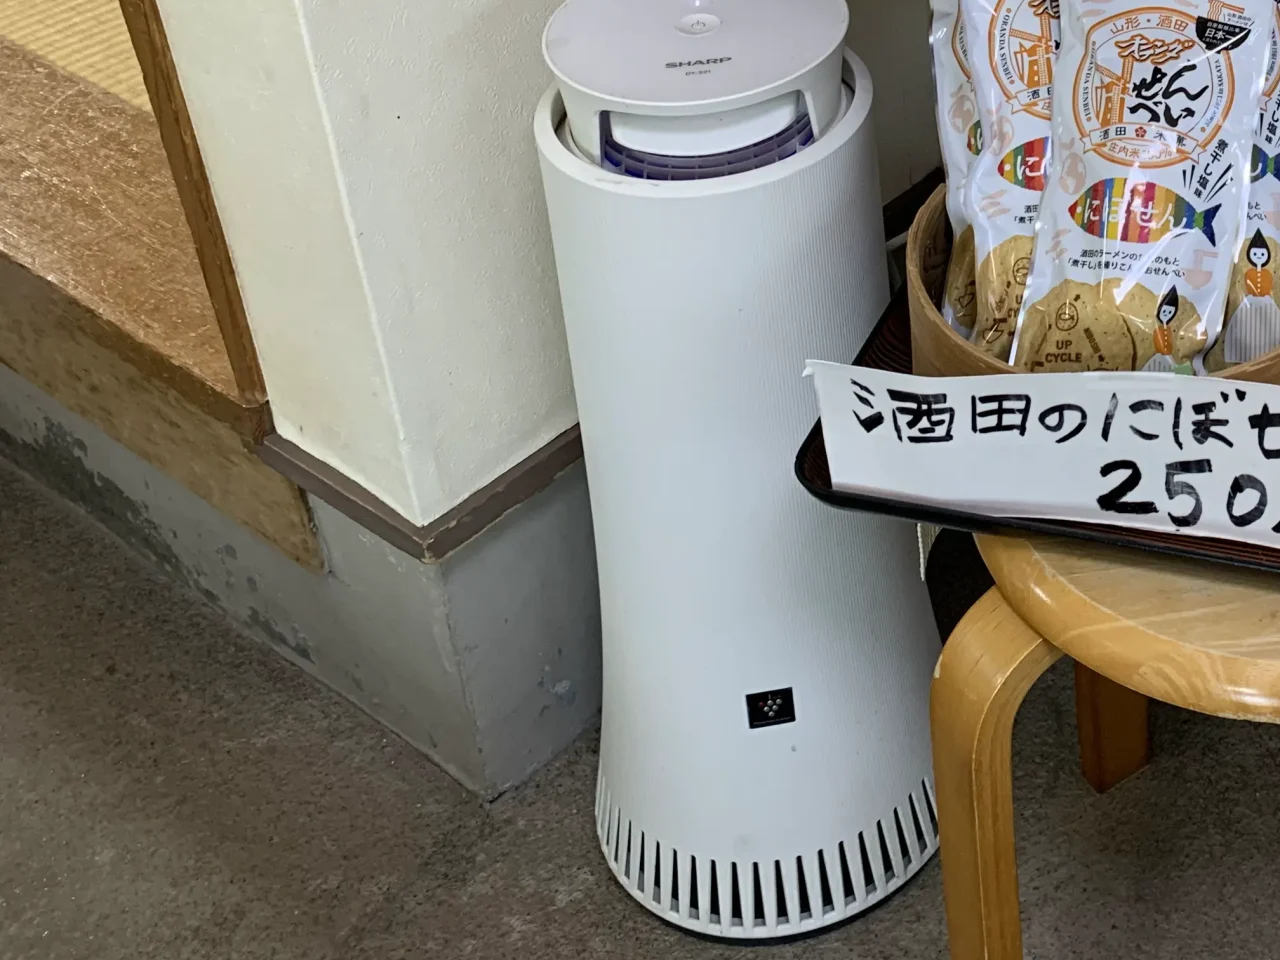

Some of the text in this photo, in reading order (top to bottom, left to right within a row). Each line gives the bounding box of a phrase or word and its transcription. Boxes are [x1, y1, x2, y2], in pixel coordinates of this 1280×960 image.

[1109, 13, 1190, 36] 山形・酒田
[664, 56, 733, 69] SHARP
[1130, 57, 1210, 103] せん
[1126, 100, 1196, 128] べい
[1098, 125, 1127, 141] 酒田
[1193, 138, 1230, 200] 煮干し塩味
[1083, 196, 1188, 231] にぼせん
[1080, 248, 1180, 267] 酒田のラーメンののもと
[1055, 340, 1073, 351] UP
[1045, 352, 1083, 364] CYCLE
